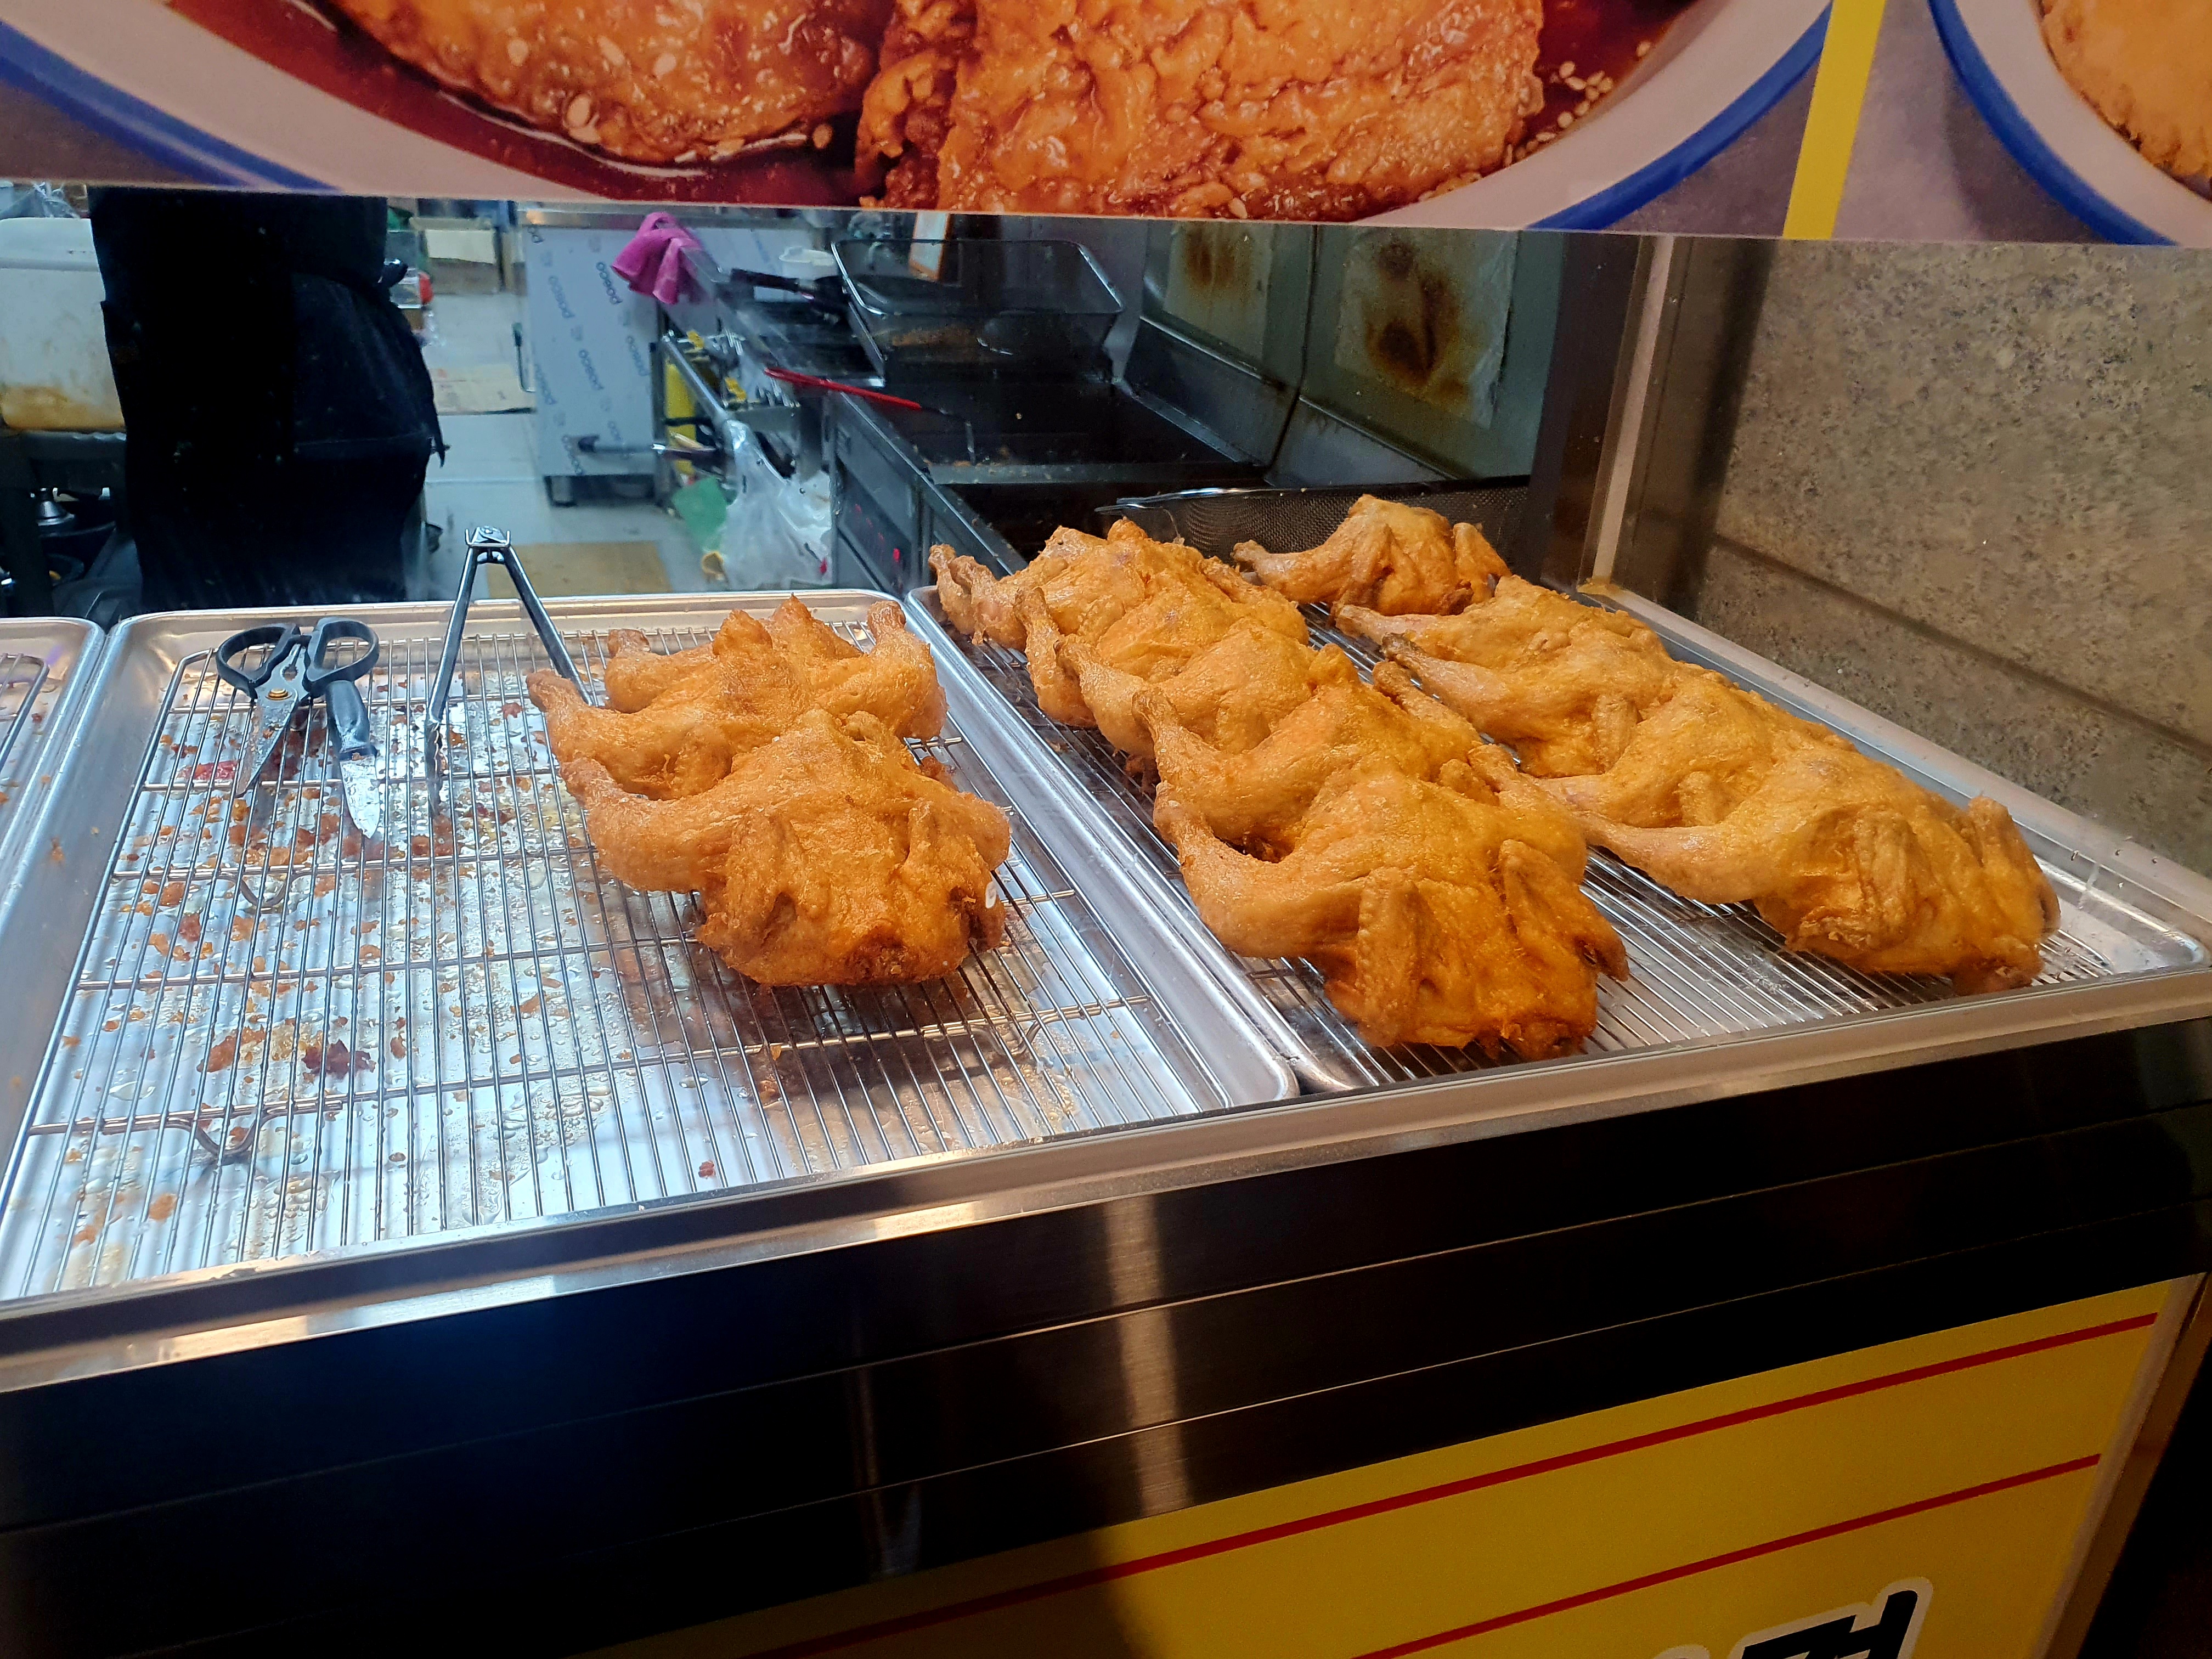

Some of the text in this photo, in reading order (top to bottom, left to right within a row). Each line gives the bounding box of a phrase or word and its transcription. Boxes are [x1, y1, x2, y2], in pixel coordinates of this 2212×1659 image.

[549, 276, 575, 319] posco
[596, 262, 623, 305] posco
[579, 349, 604, 391] posco
